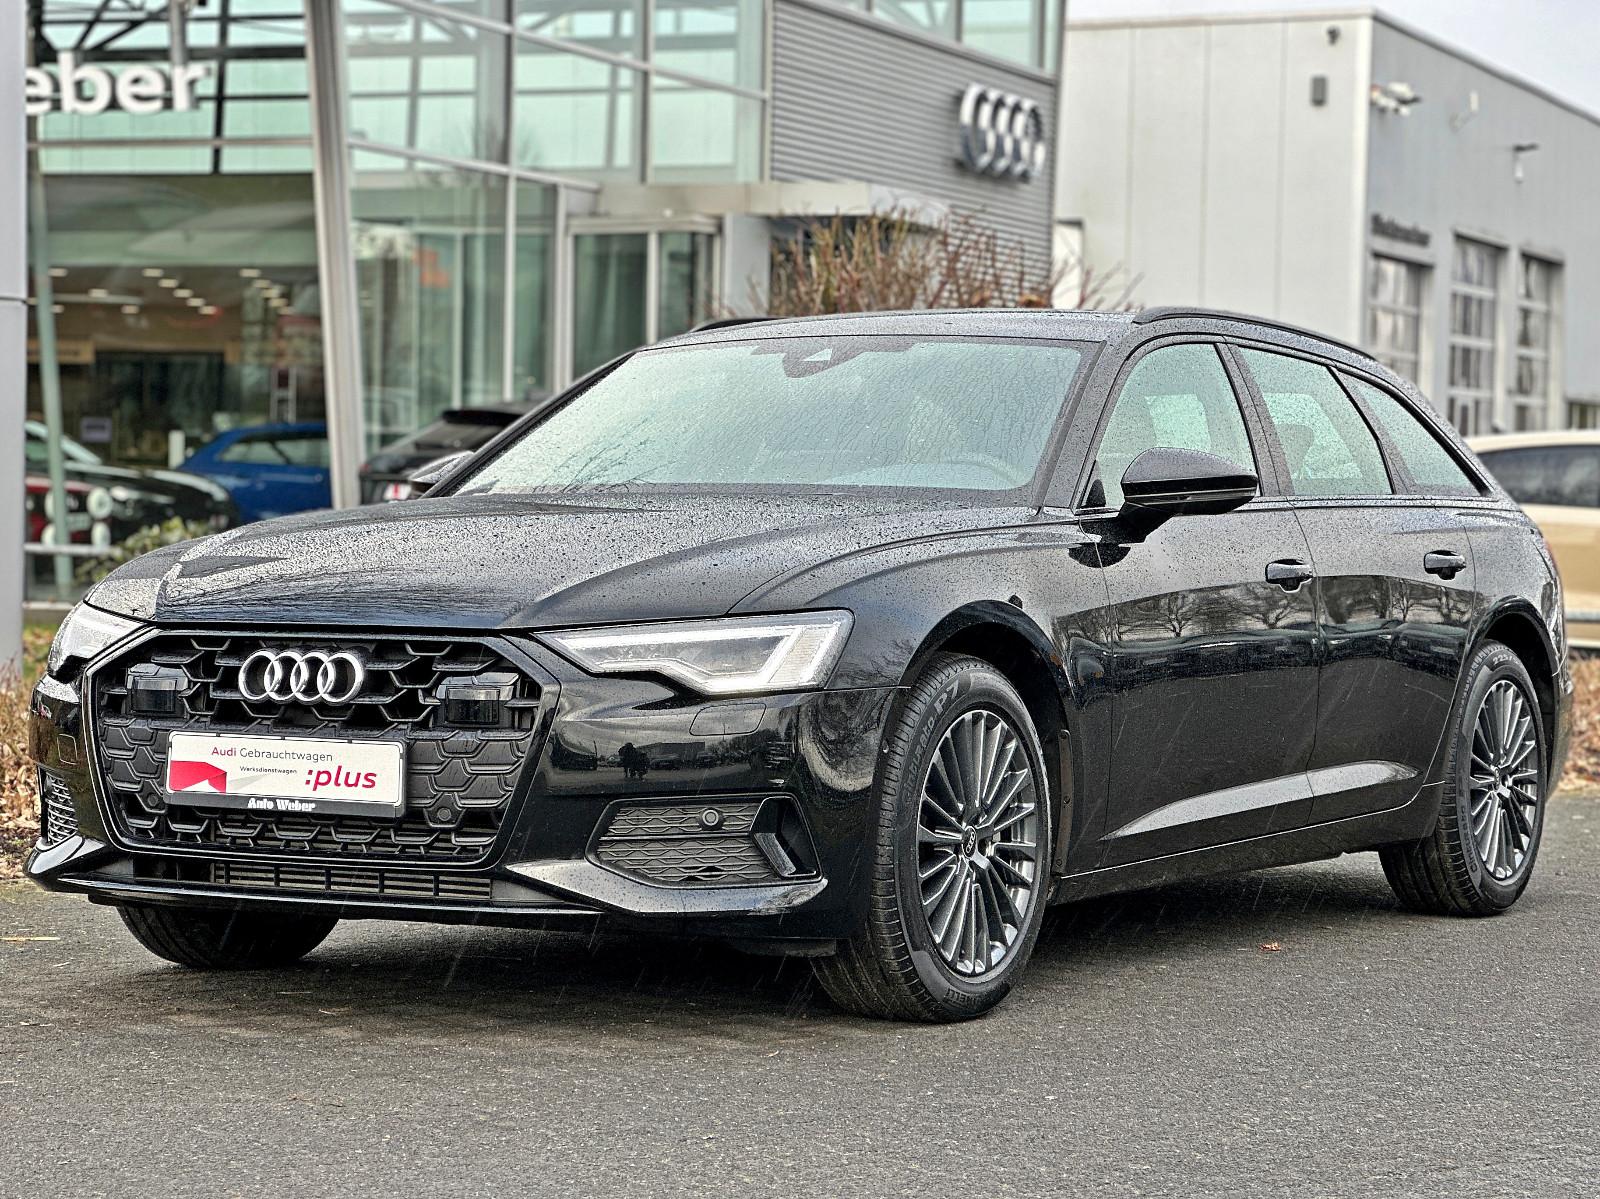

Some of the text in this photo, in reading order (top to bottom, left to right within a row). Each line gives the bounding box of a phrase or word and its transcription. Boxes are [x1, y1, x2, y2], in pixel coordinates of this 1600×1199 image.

[934, 679, 959, 715] P7
[211, 746, 333, 763] Audi Gebrauchtwagen
[240, 765, 298, 776] Werksdienstwagen
[304, 765, 377, 792] :plus
[247, 797, 316, 812] Auto Weber
